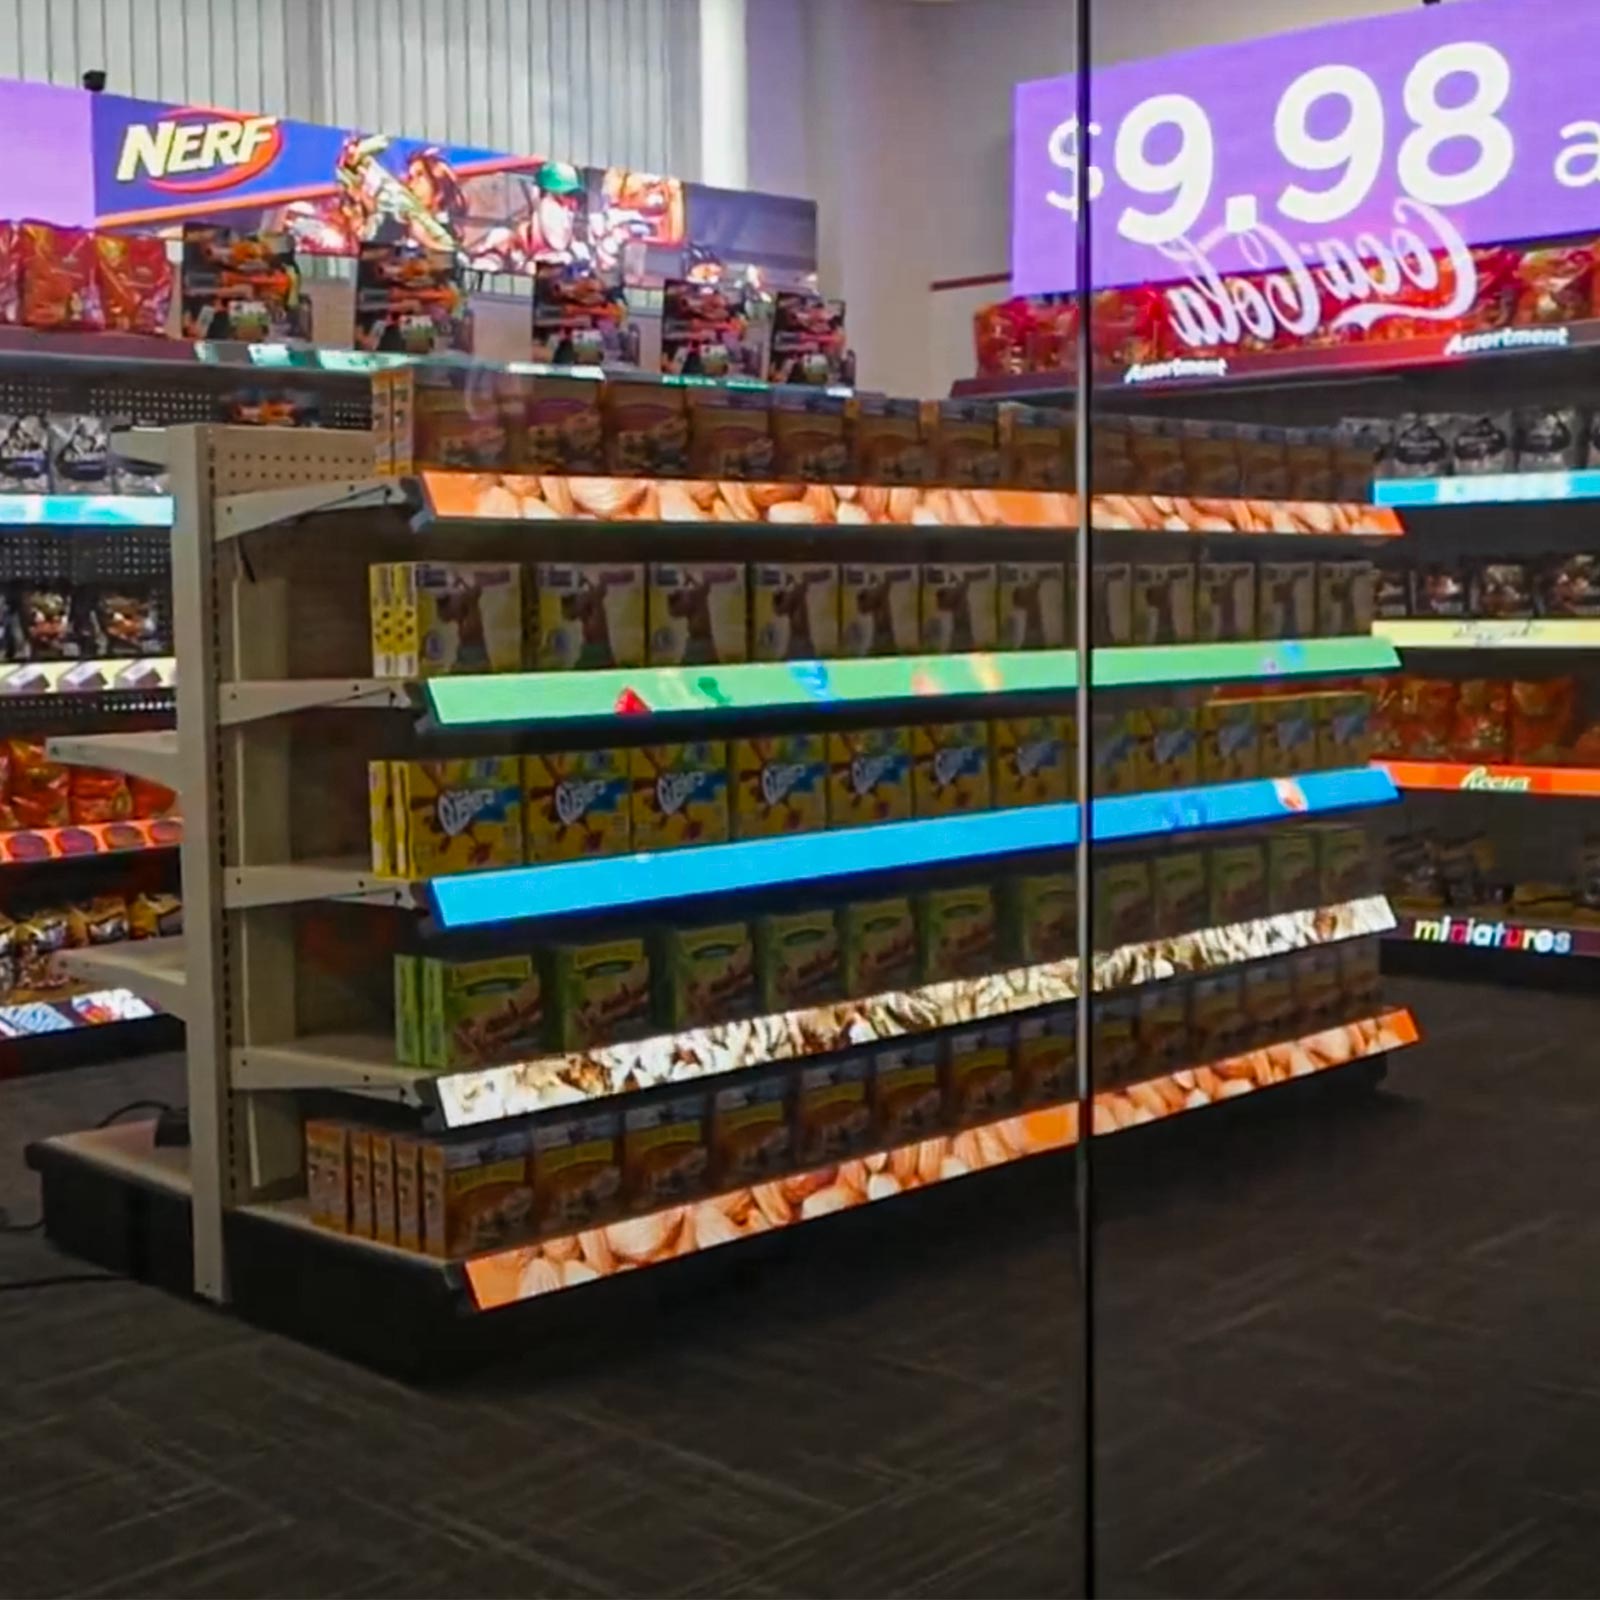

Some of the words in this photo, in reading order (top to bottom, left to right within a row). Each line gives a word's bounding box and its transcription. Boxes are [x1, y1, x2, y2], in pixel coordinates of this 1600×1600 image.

[116, 116, 277, 181] NERF
[1444, 327, 1569, 356] Assortment
[1413, 915, 1571, 953] miniatures
